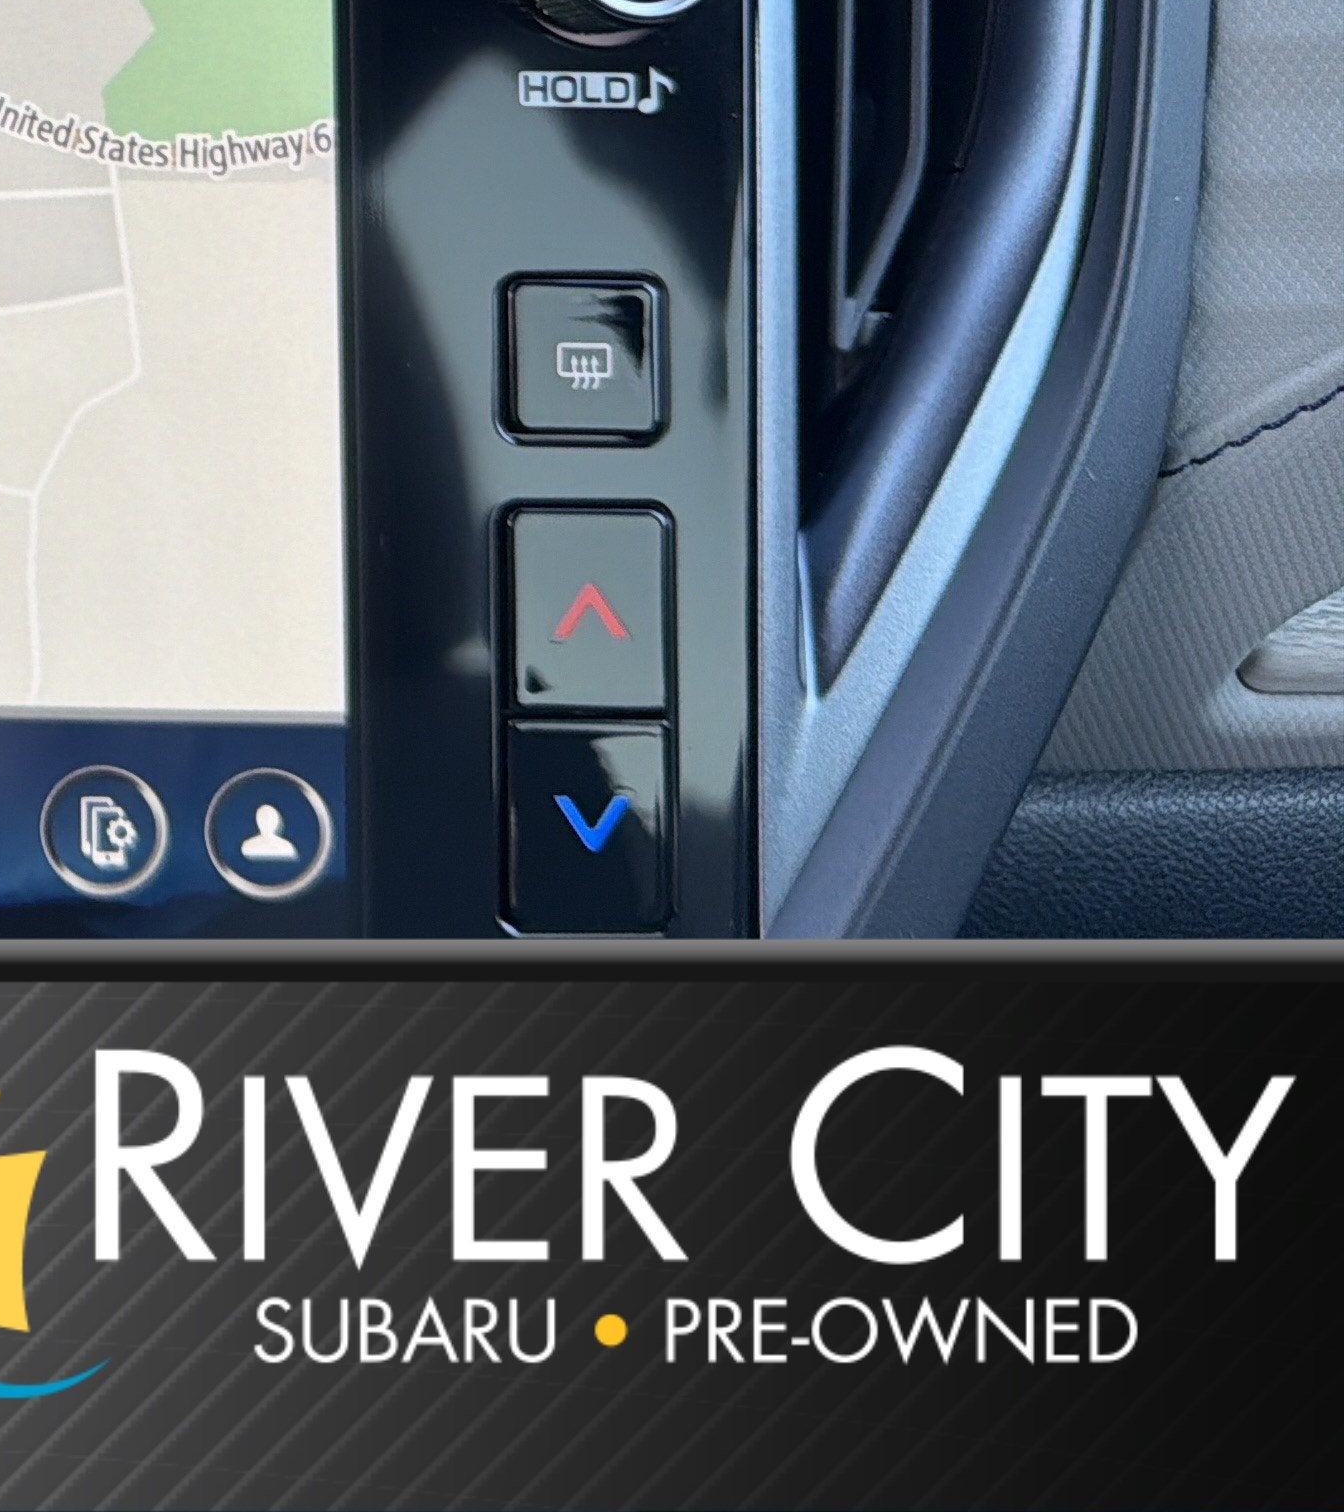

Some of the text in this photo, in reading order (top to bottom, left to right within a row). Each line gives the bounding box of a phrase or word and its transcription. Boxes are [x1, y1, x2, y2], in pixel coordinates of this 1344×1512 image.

[520, 72, 635, 107] HOLD
[78, 125, 170, 168] States
[179, 133, 305, 176] Highway
